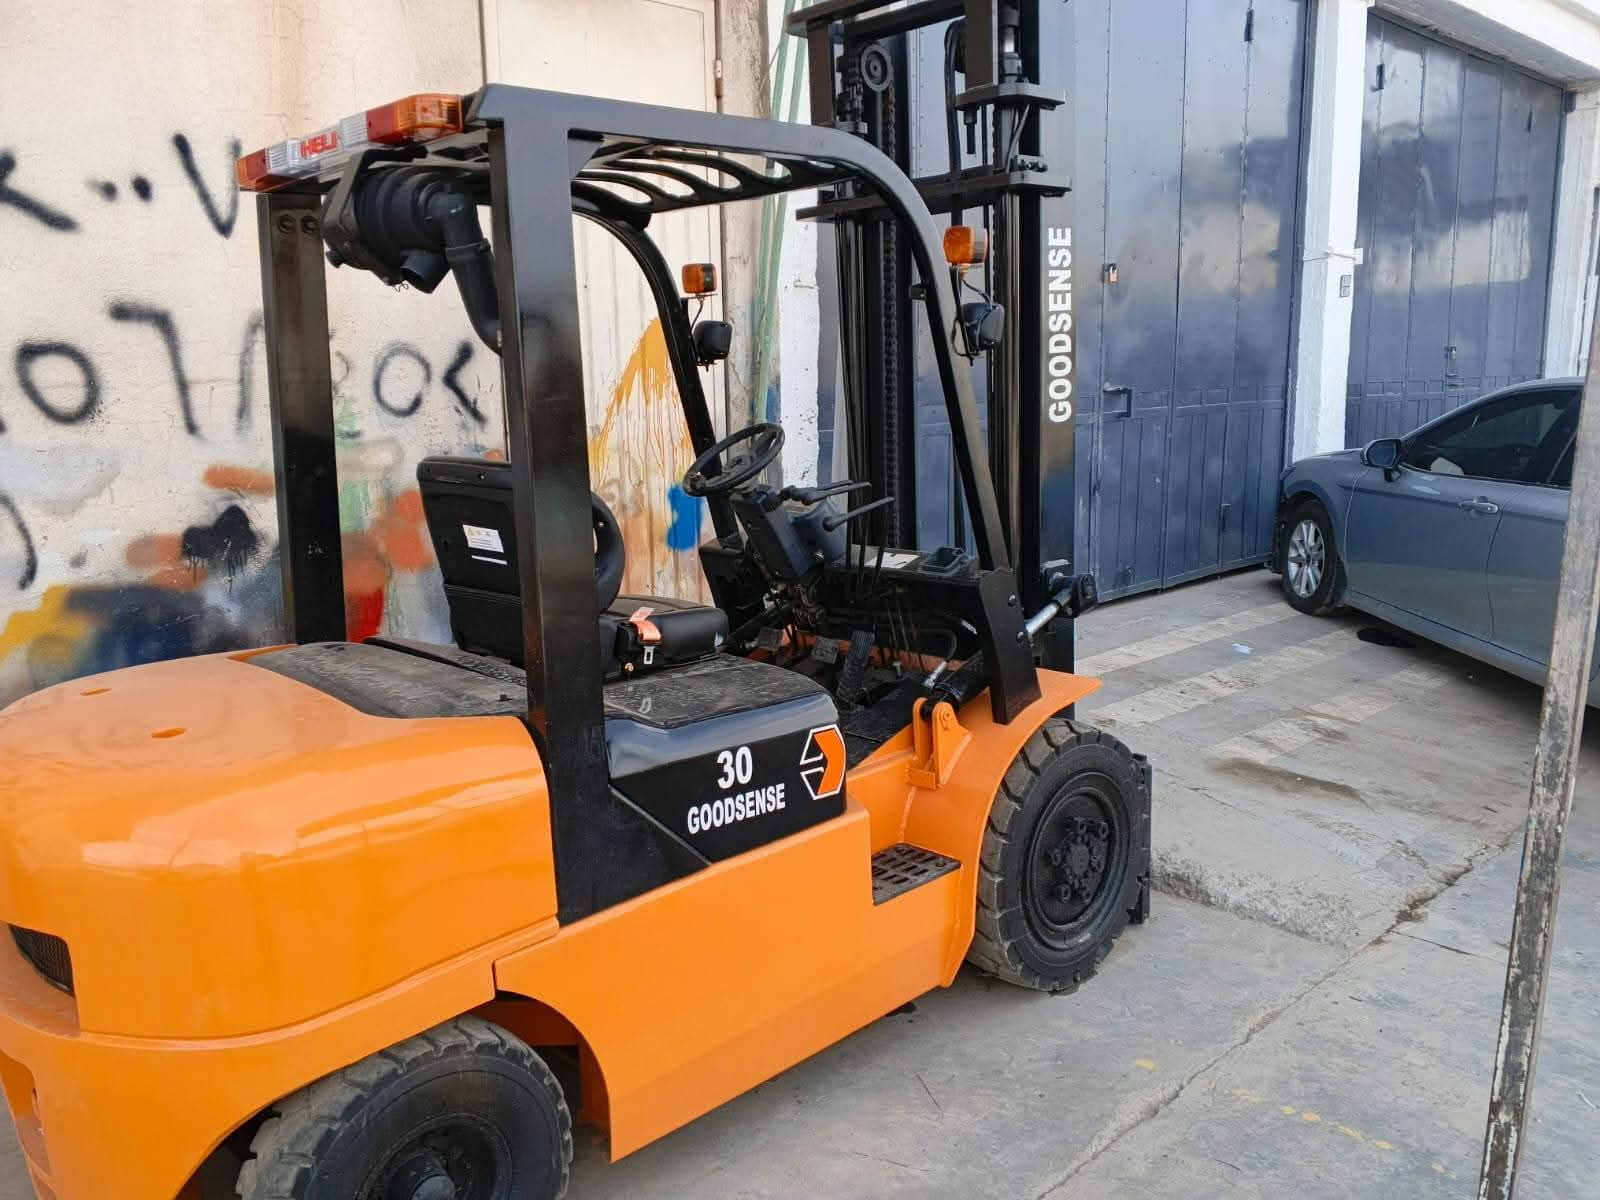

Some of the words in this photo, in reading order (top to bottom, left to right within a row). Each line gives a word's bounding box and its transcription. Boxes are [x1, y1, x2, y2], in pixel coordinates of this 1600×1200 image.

[300, 129, 338, 160] HELI
[1047, 227, 1073, 423] GOODSENSE
[716, 745, 753, 790] 30
[687, 782, 786, 835] GOODSENSE
